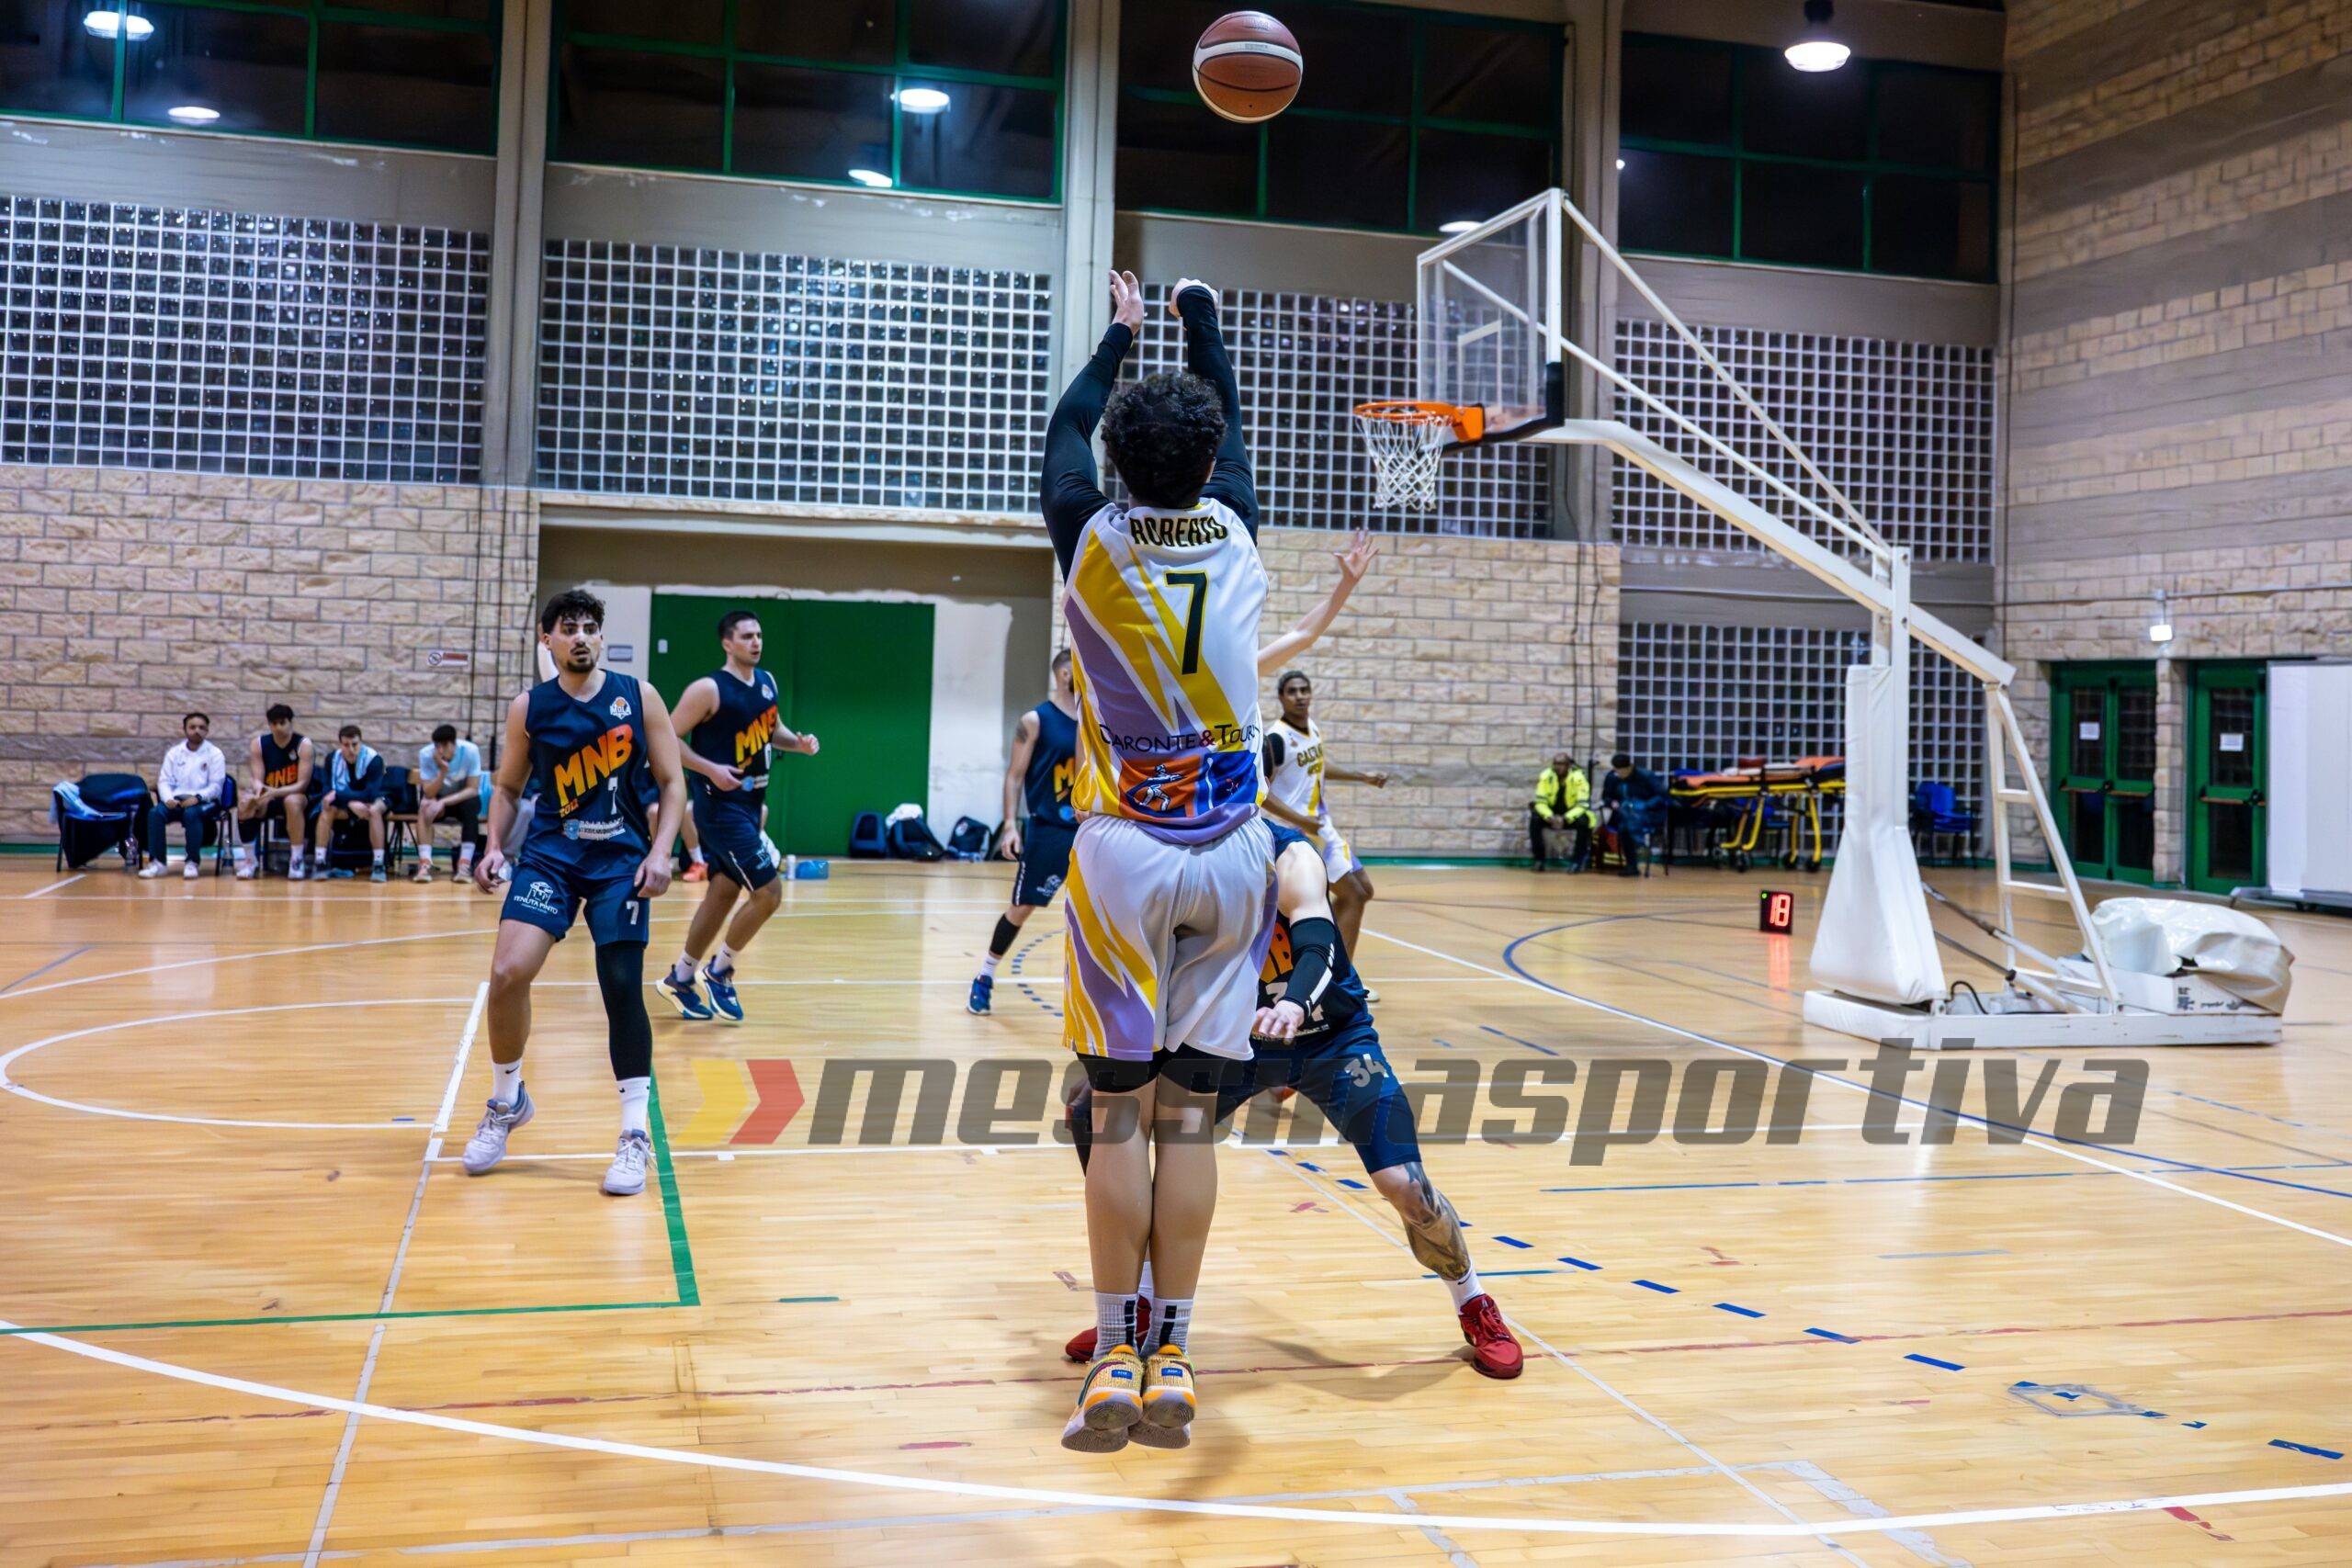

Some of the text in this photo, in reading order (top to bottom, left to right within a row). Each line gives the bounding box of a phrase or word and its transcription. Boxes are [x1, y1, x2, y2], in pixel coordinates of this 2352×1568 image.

[1164, 570, 1210, 676] 7
[554, 723, 634, 807] MNB
[607, 775, 618, 815] 7
[626, 900, 639, 925] 7
[1770, 894, 1791, 927] 18
[1344, 1053, 1390, 1088] 34
